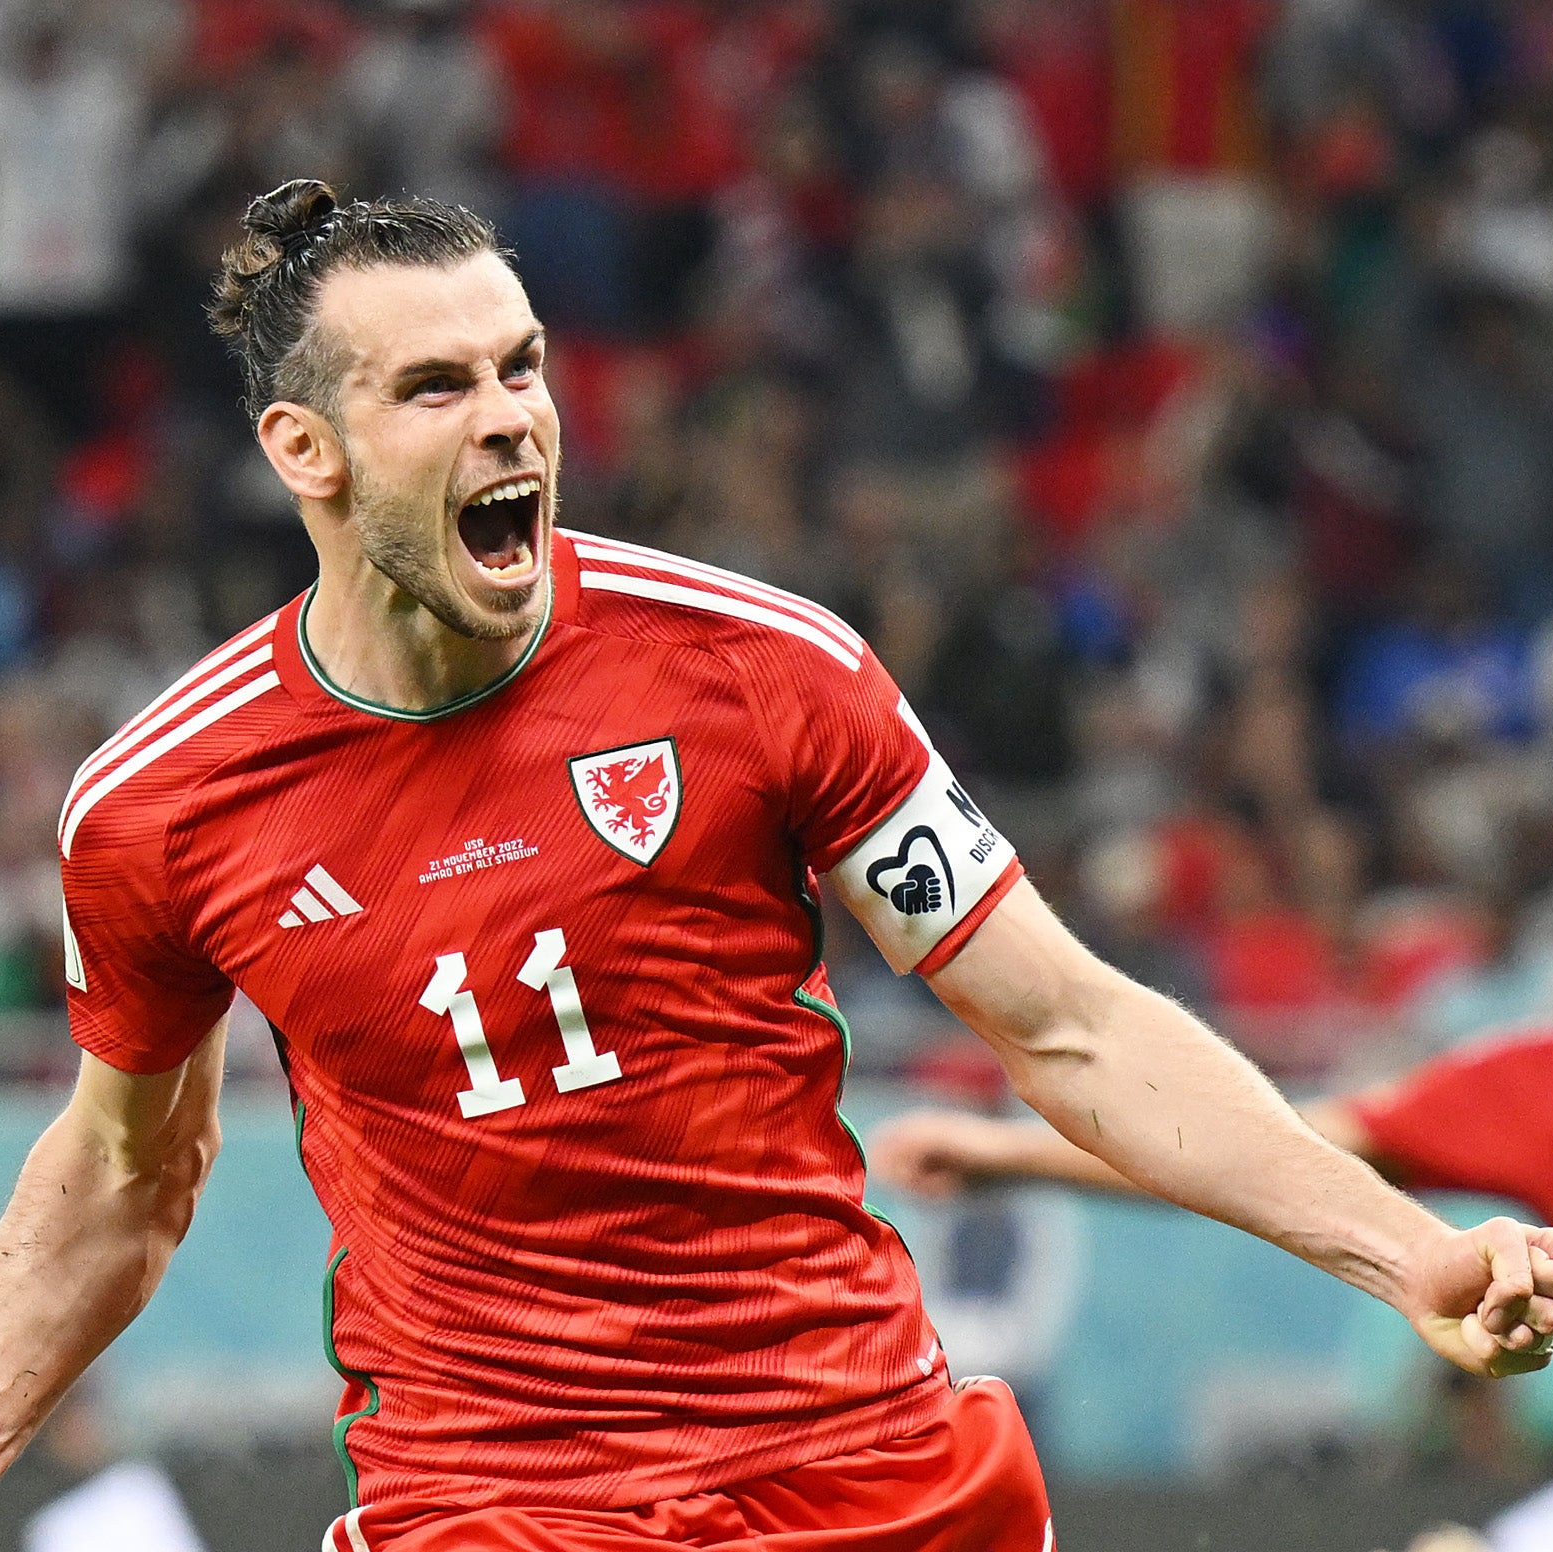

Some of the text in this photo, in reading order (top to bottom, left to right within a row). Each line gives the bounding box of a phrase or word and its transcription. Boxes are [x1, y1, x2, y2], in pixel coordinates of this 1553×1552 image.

[428, 839, 524, 871] 21 NOVEMBER 2022
[463, 838, 485, 851] USA
[418, 846, 539, 884] AHMAD BIN ALI STADIUM
[418, 927, 623, 1119] 11
